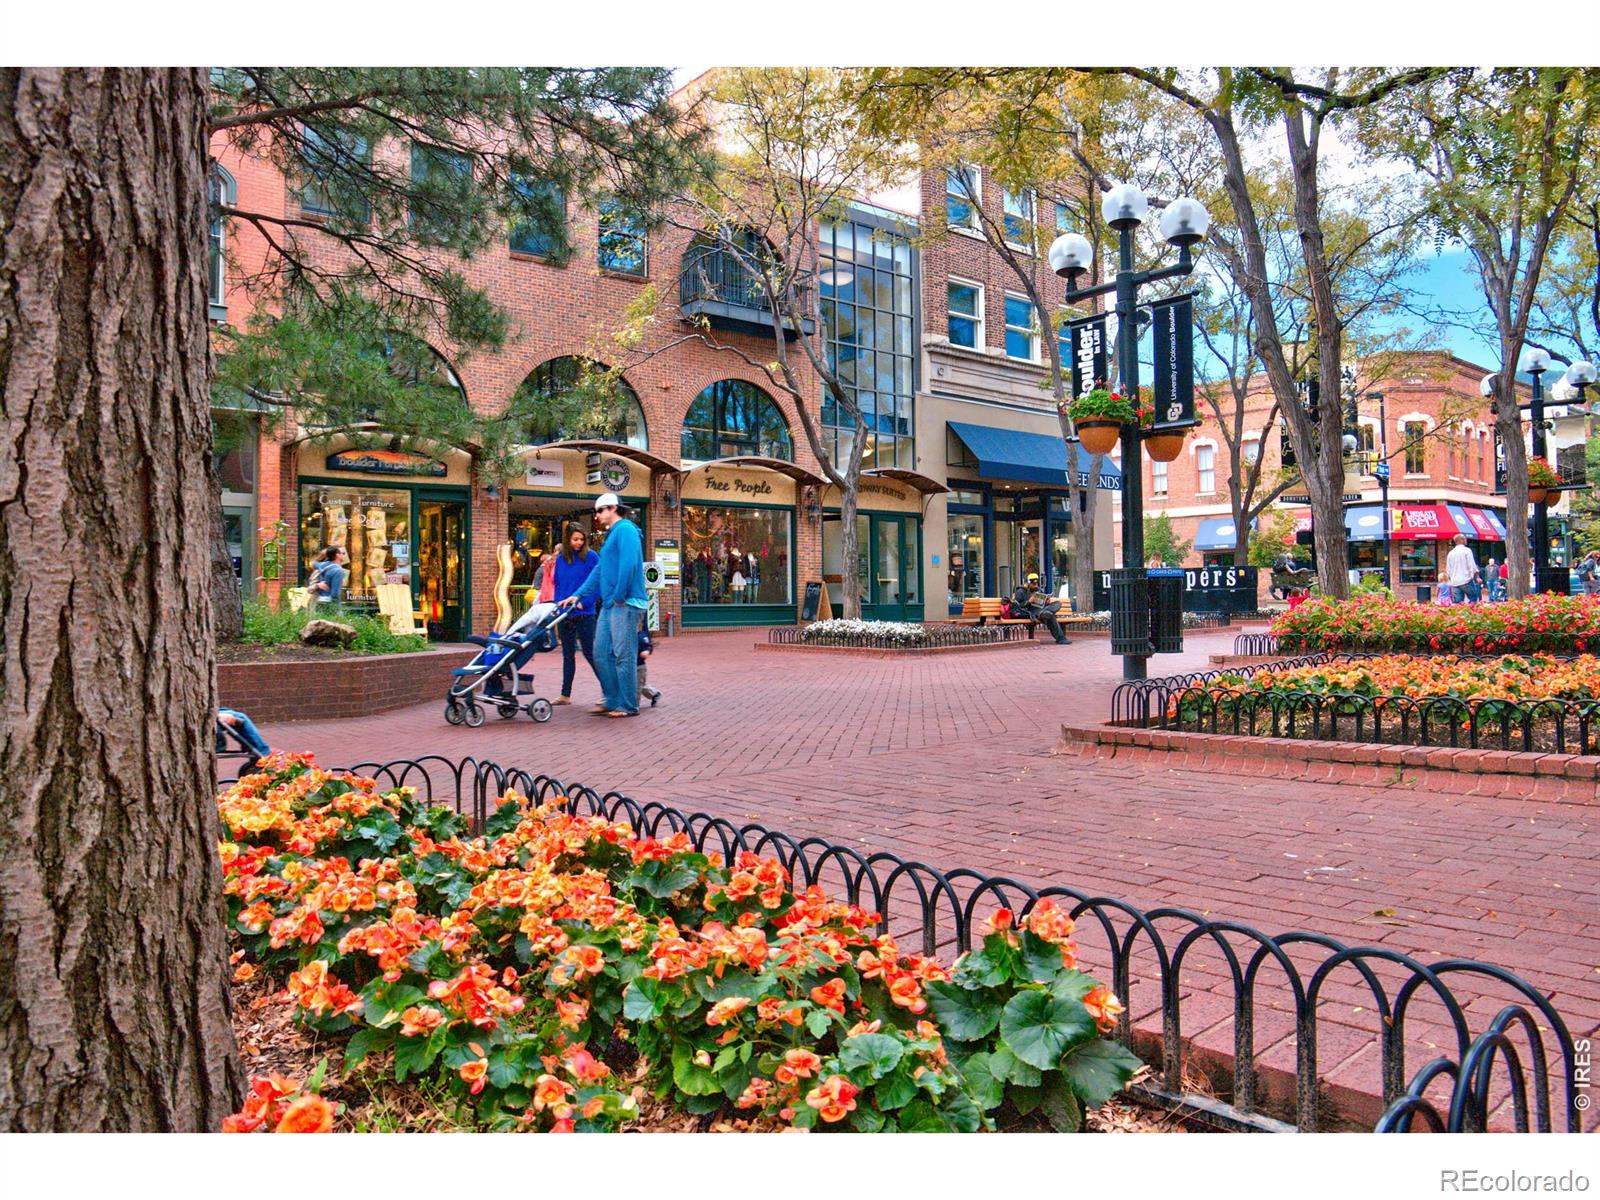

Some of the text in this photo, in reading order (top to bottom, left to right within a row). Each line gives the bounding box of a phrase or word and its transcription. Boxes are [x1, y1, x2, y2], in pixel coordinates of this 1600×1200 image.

[1093, 329, 1101, 346] LAW
[1169, 333, 1177, 362] Colorado
[1170, 371, 1178, 401] University
[704, 477, 773, 498] Free People
[1065, 471, 1120, 490] EENDS
[319, 494, 395, 508] Custom Furniture
[346, 590, 377, 600] Furnitur
